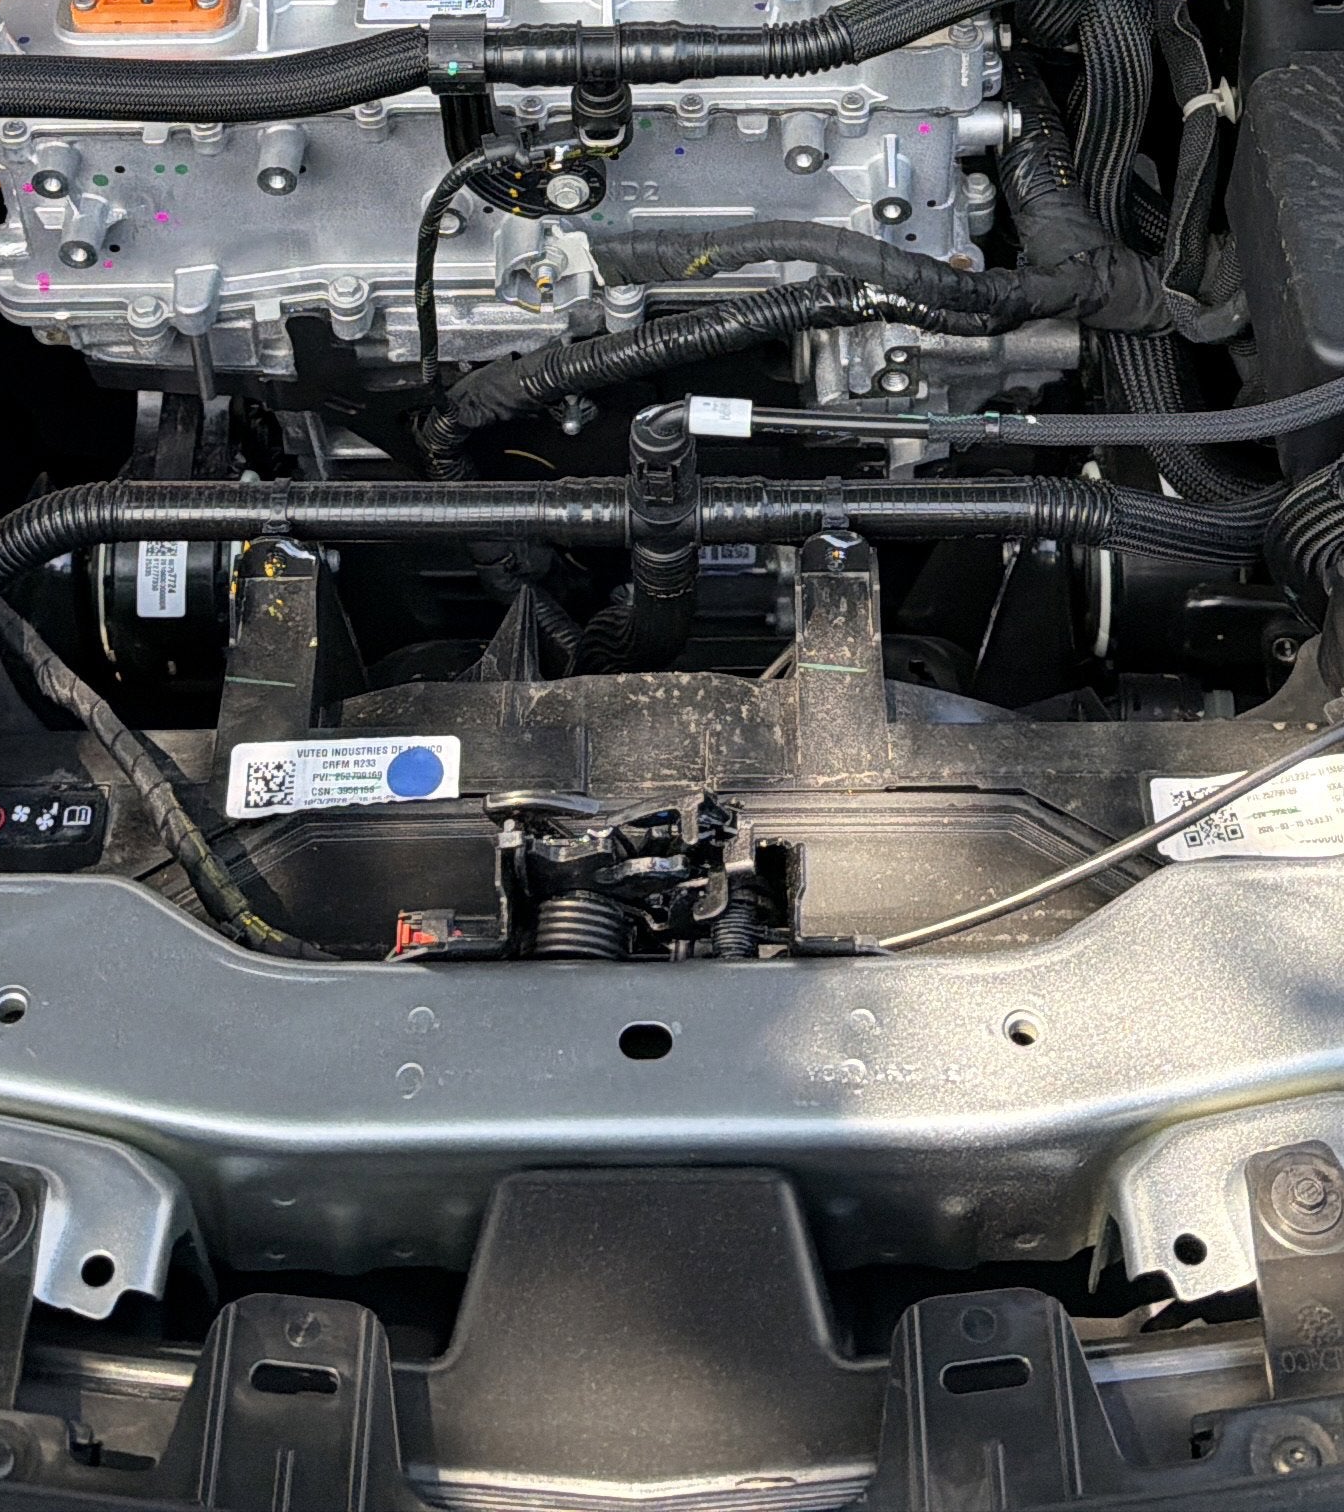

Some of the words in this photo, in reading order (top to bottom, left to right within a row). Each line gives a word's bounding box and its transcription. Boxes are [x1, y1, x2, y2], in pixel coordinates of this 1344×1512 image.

[331, 745, 389, 757] INDUSTRIES
[322, 759, 350, 770] CRFM
[353, 758, 377, 768] R233
